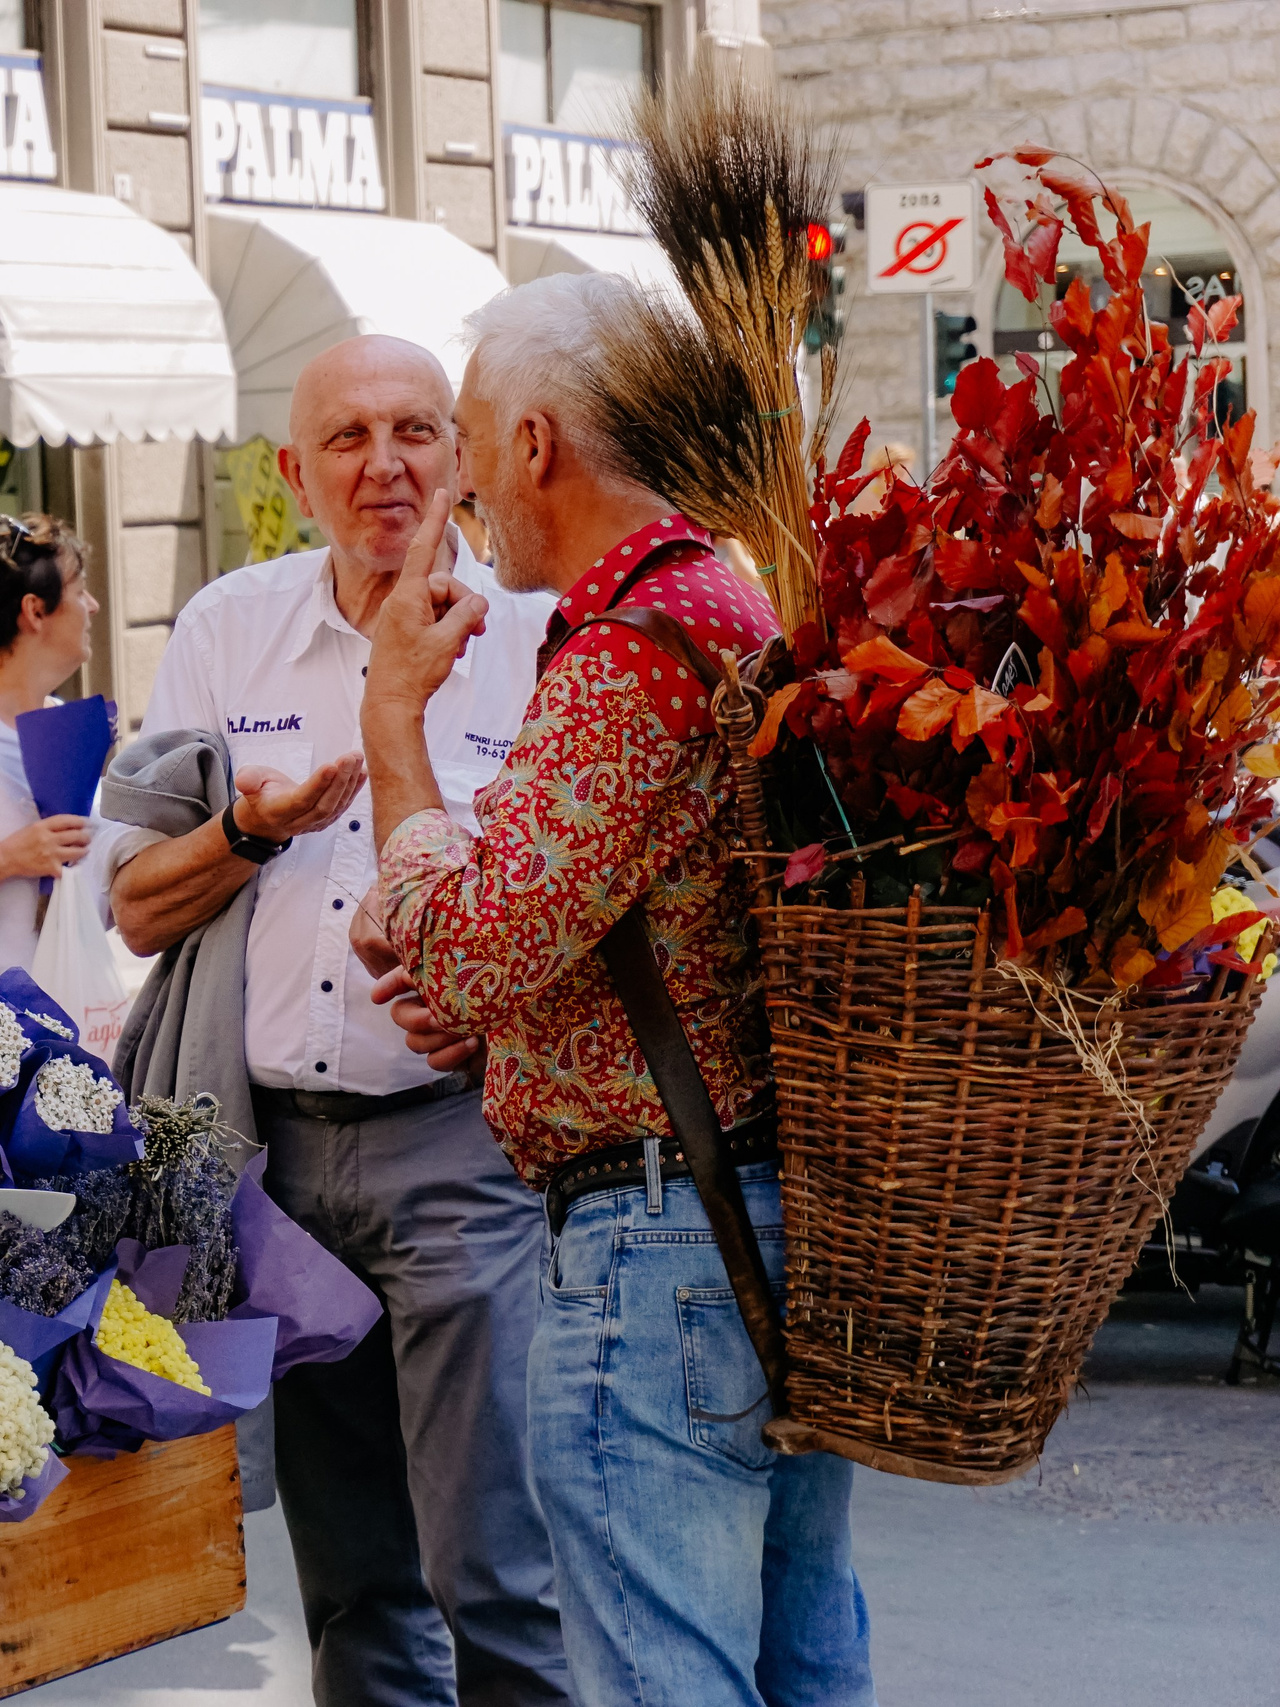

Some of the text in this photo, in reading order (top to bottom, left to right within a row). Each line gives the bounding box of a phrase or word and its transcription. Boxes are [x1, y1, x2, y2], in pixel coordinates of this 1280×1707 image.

[200, 97, 385, 210] PALMA
[465, 732, 515, 748] HENRI LLOY
